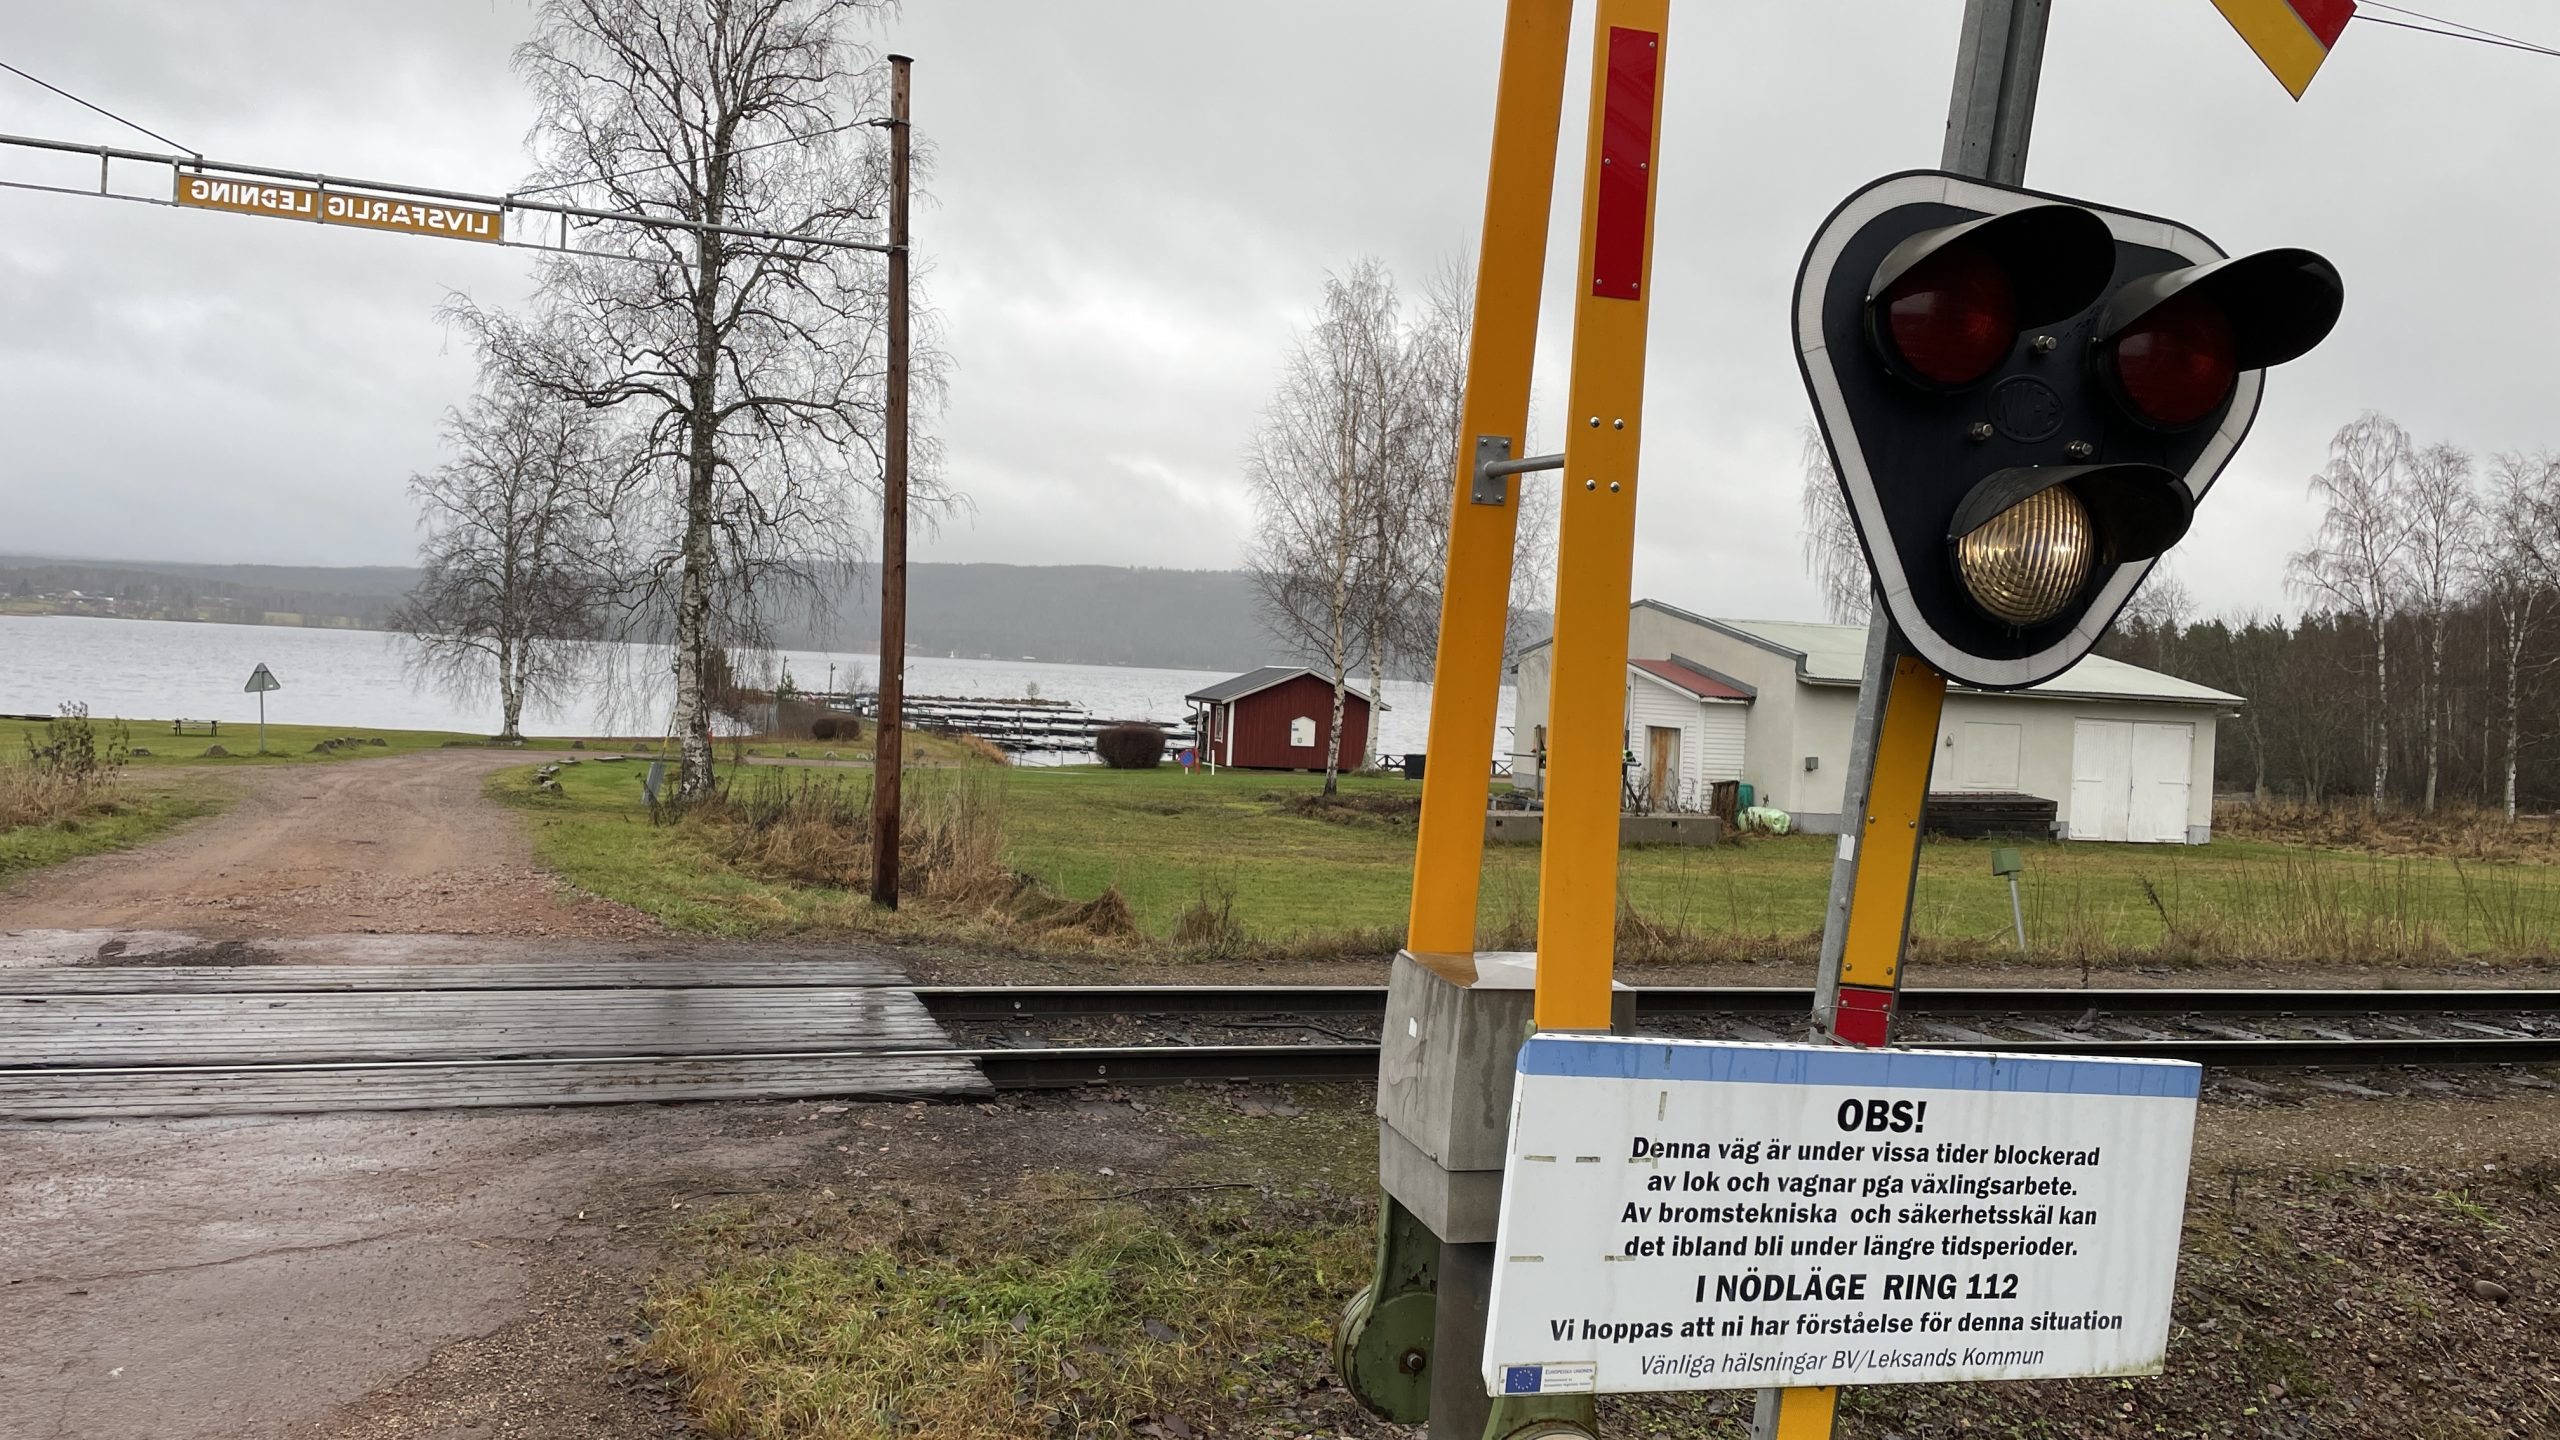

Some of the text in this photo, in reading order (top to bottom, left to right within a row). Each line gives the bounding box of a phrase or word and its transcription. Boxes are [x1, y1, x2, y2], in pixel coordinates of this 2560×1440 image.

[1838, 1099, 1927, 1133] OBS!
[1632, 1136, 2100, 1165] Denna väg är under vissa tider blockerad
[1648, 1171, 2076, 1199] av lok och vagnar pga växlingsarbete.
[1621, 1202, 2096, 1224] Av bromstekniska och säkerhetsskäl kan
[1625, 1235, 2077, 1260] det ibland bli under längre tidsperioder.
[1696, 1267, 2018, 1302] I NÖDLÄGE RING 112
[1551, 1311, 2122, 1343] Vi hoppas att ni har förståelse för denna situation
[1643, 1348, 2043, 1377] Vänliga hälsningar BV/Leksands Kommun
